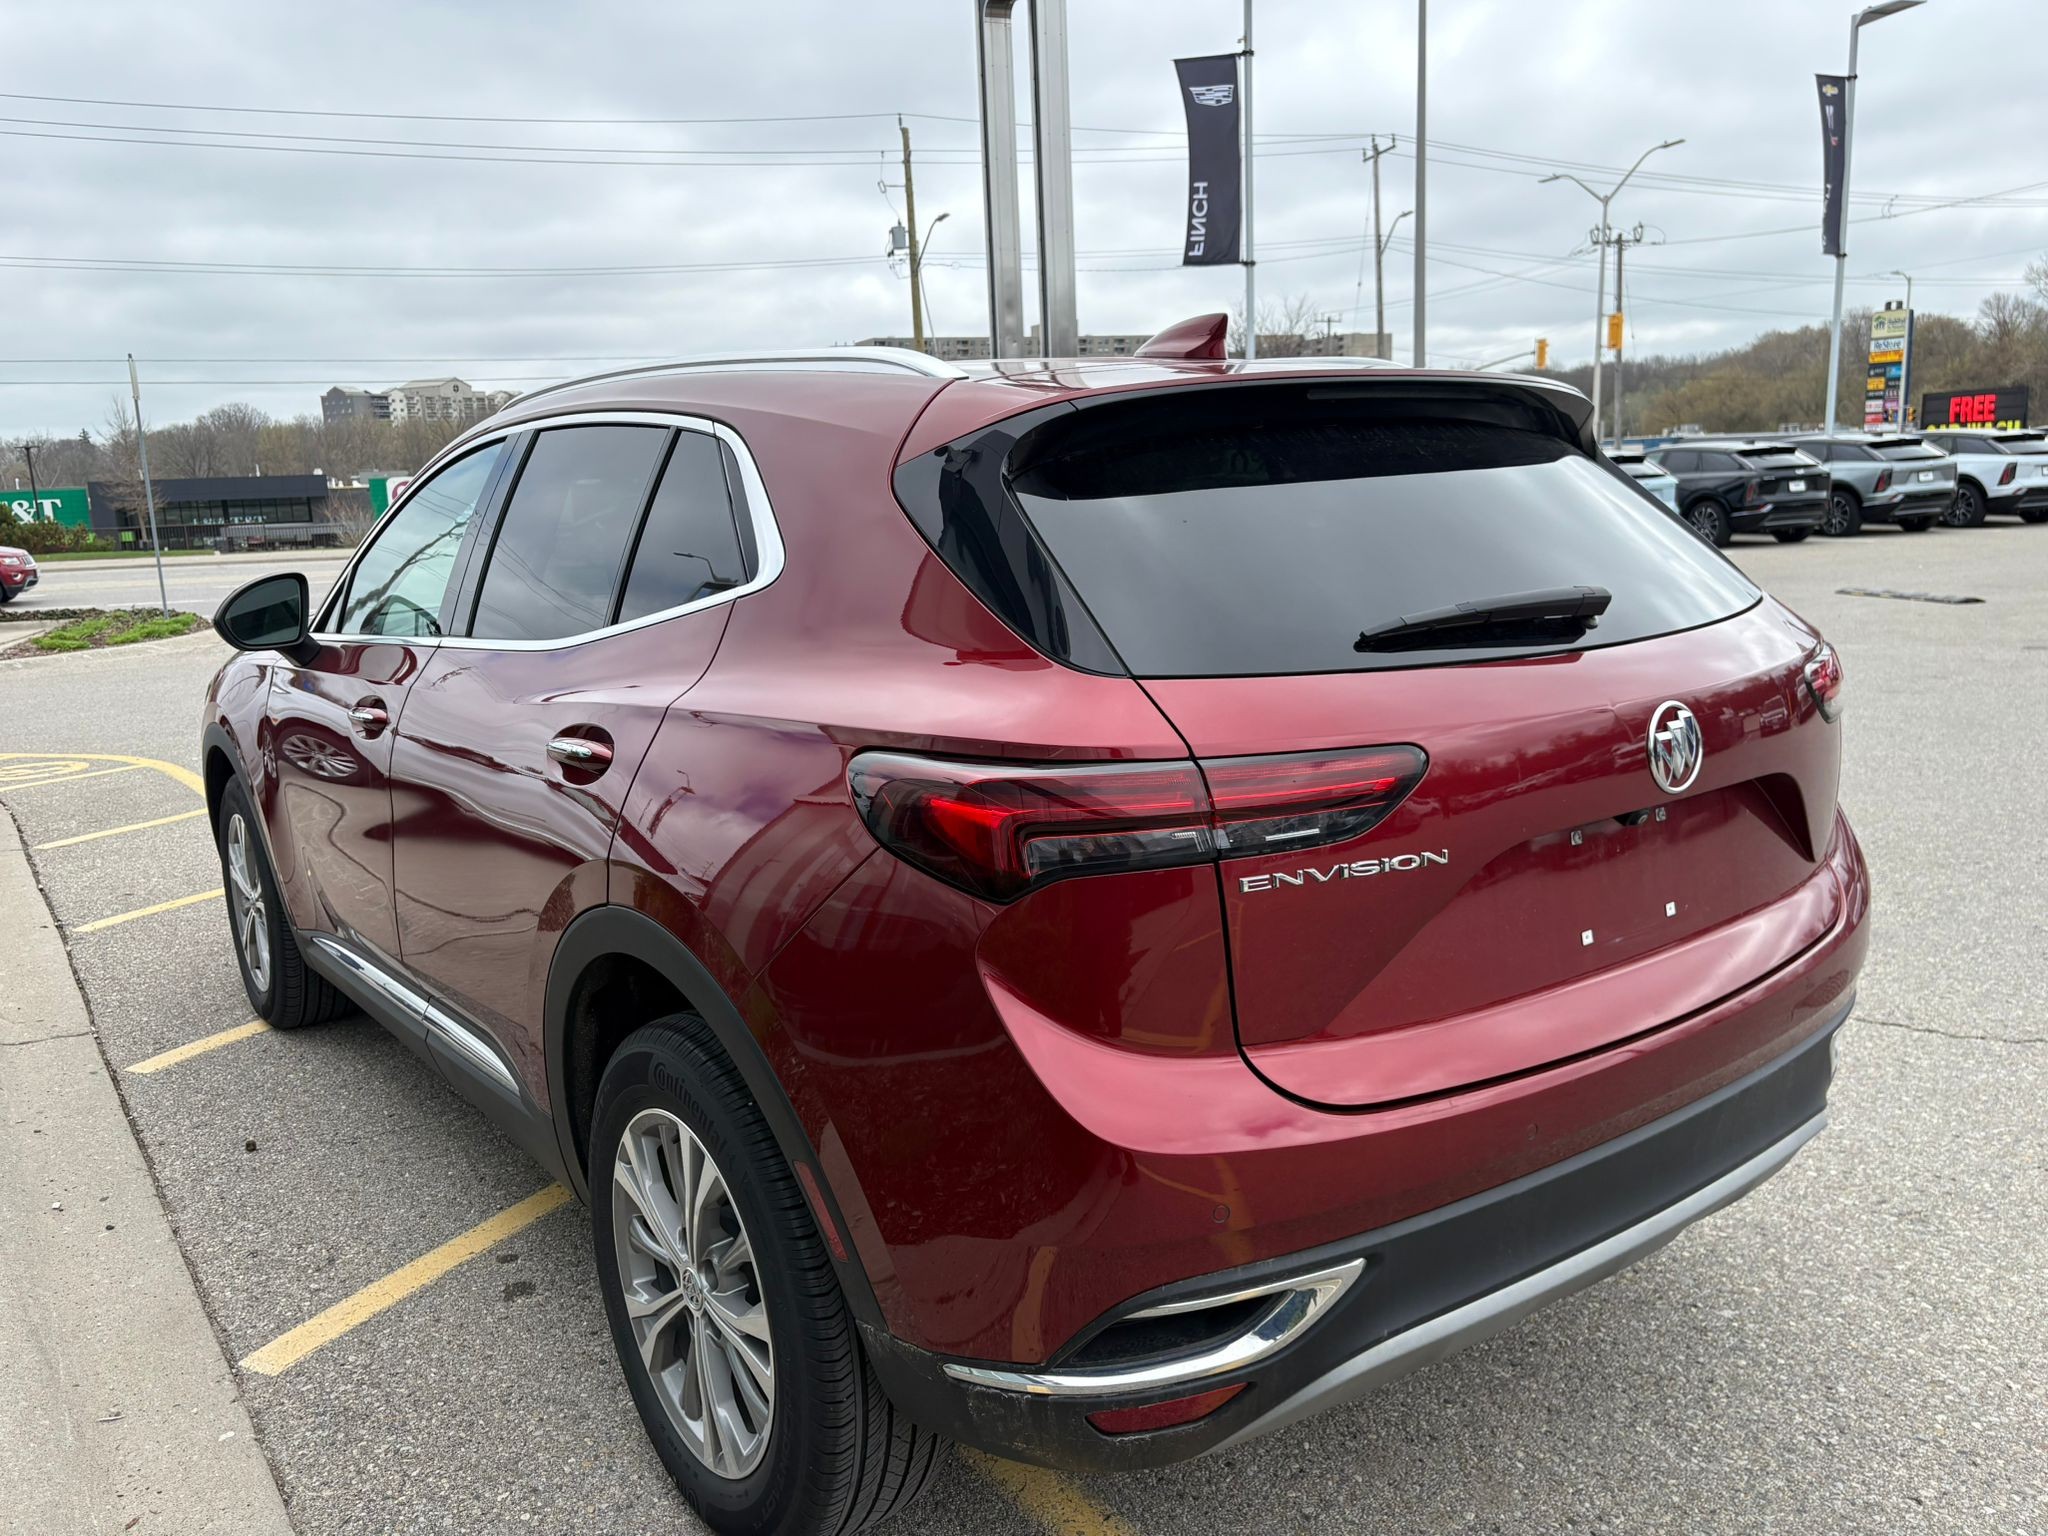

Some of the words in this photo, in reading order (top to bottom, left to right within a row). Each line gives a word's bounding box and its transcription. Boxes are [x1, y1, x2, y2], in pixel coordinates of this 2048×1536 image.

[1950, 394, 1997, 422] FREE
[0, 499, 62, 525] &T
[1240, 849, 1449, 893] ENVISION
[654, 1062, 728, 1157] Continental
